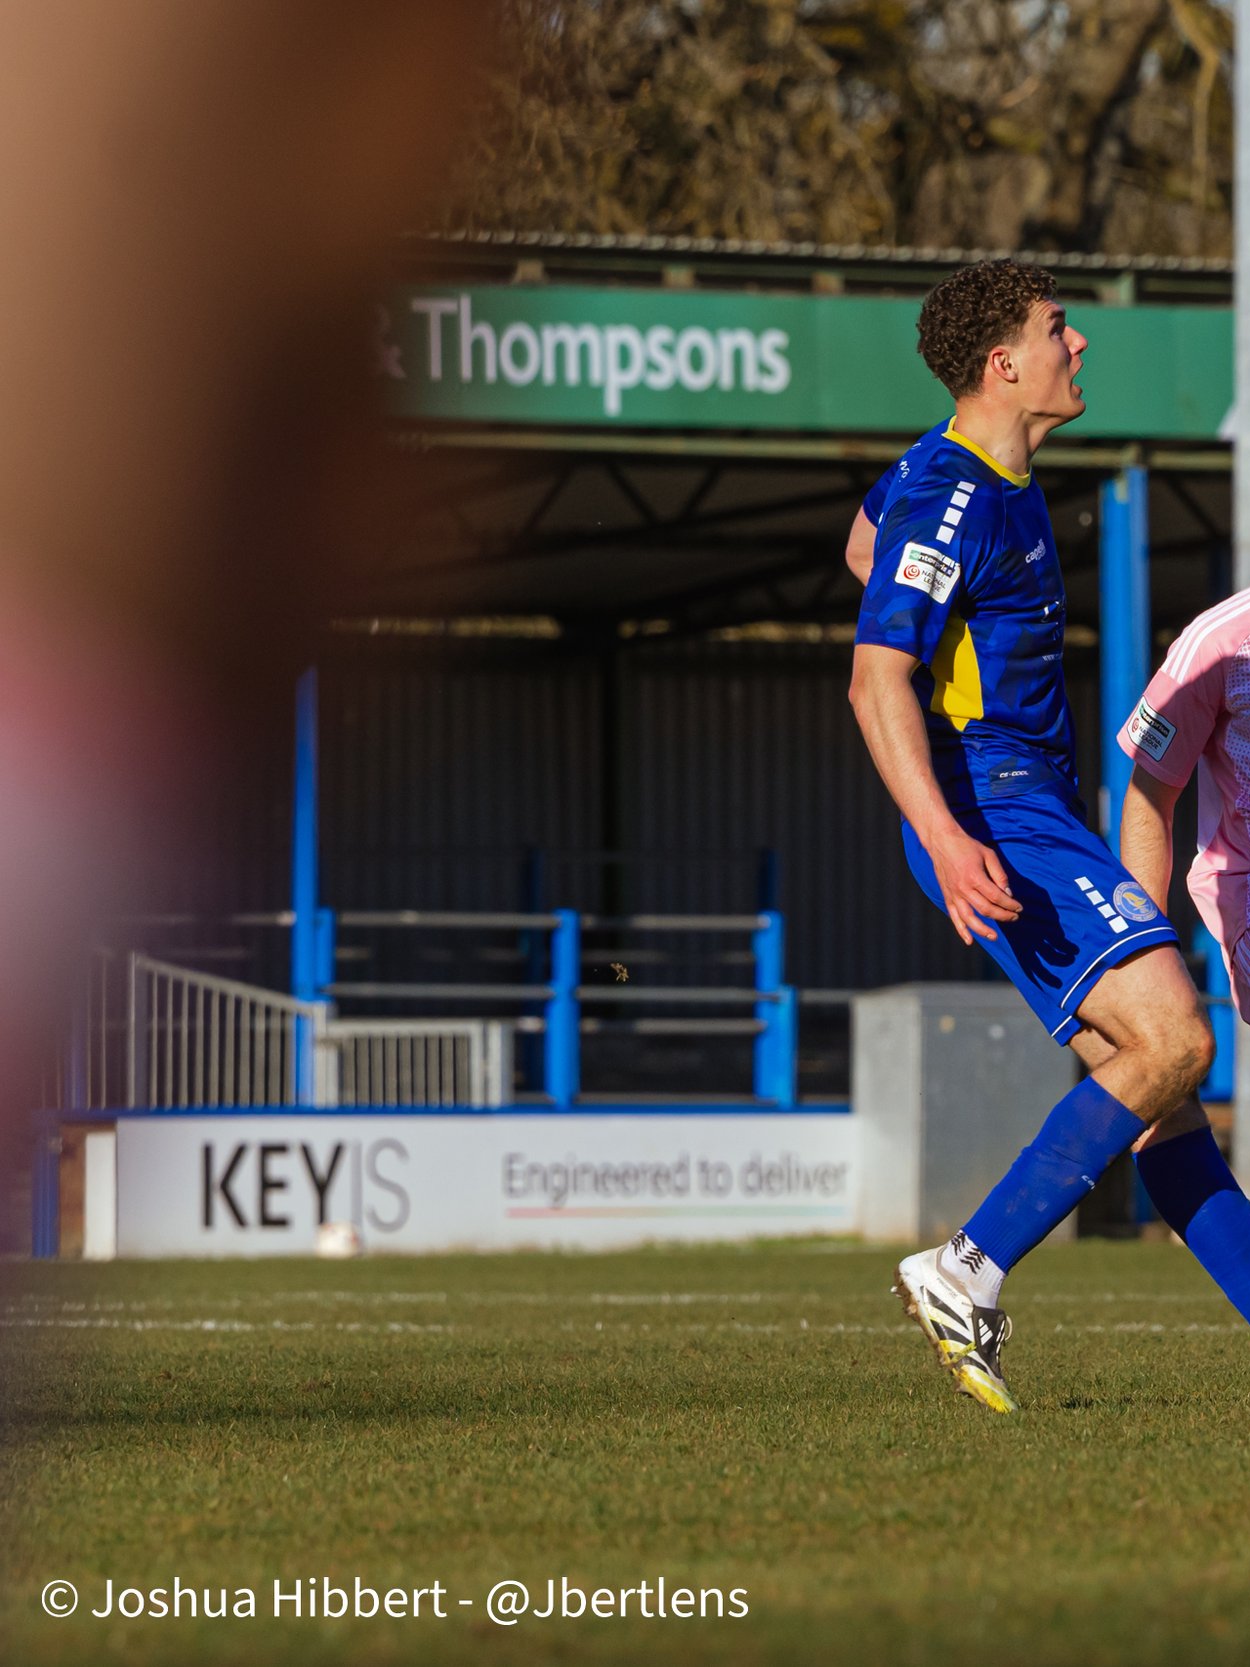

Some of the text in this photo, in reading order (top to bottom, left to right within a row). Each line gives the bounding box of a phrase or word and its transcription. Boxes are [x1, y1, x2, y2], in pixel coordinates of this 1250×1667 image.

[411, 293, 790, 416] Thompsons
[502, 1151, 848, 1211] Engineered to deliver
